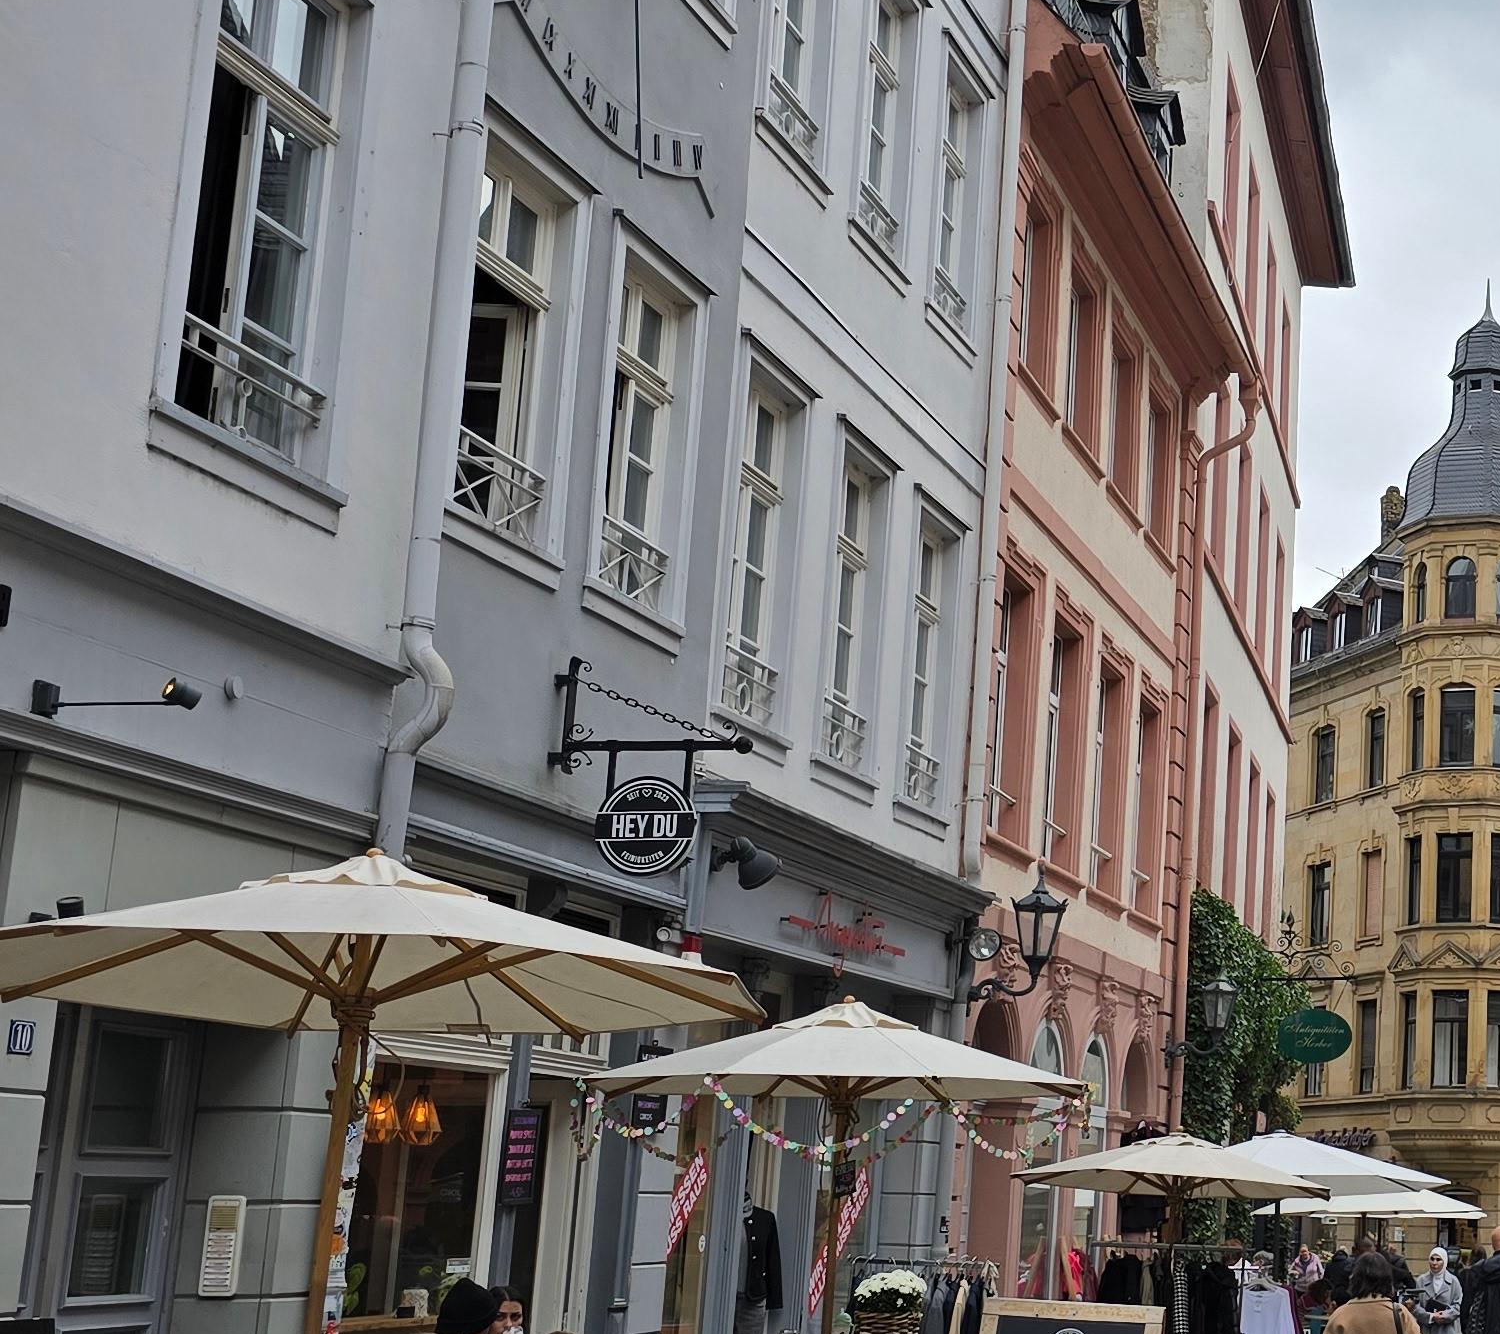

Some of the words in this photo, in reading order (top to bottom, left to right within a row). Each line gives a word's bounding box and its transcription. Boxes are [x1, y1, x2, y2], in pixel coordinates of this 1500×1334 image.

[626, 790, 640, 801] SEIT
[611, 814, 650, 838] HEY
[652, 814, 678, 838] DU
[15, 1025, 31, 1051] 10
[1284, 1021, 1345, 1037] Antiquitäten
[683, 1168, 707, 1219] RAUS
[851, 1183, 869, 1224] RAUS
